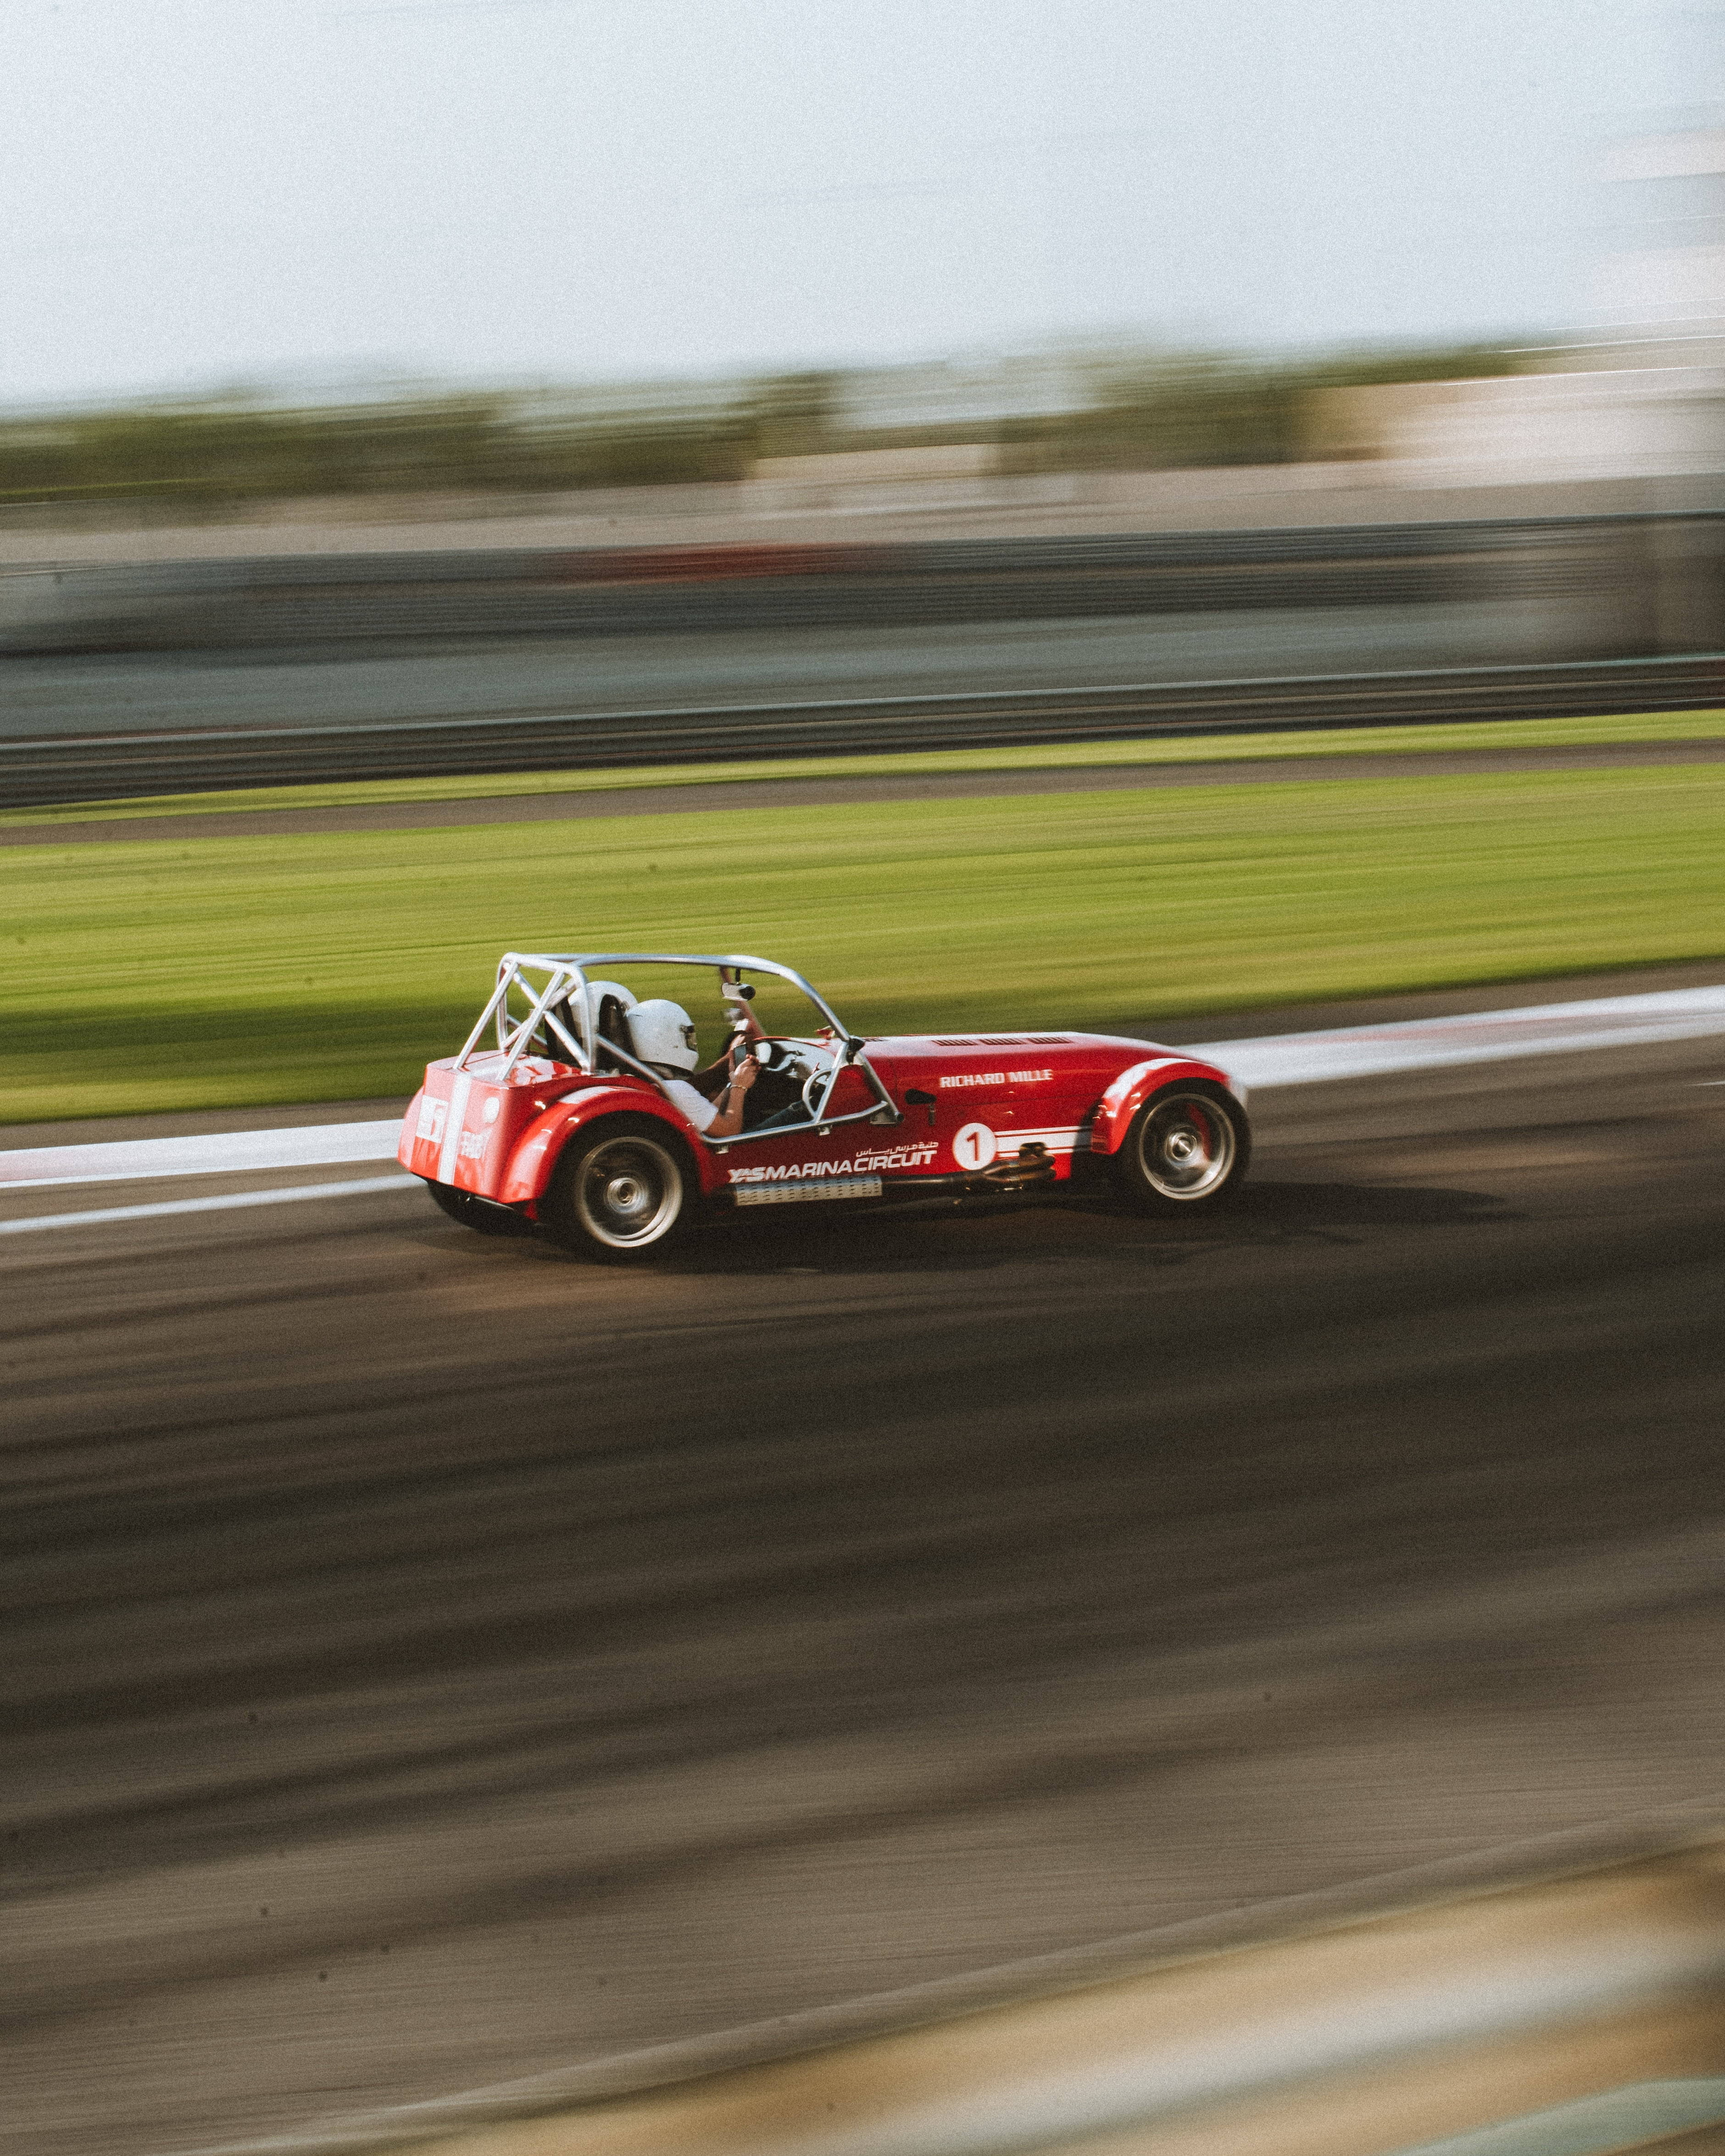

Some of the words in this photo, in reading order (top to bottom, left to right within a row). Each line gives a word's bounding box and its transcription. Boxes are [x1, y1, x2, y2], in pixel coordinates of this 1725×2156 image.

[940, 1072, 1005, 1088] RICHARD
[1009, 1069, 1054, 1082] MILLE
[967, 1132, 980, 1161] 1
